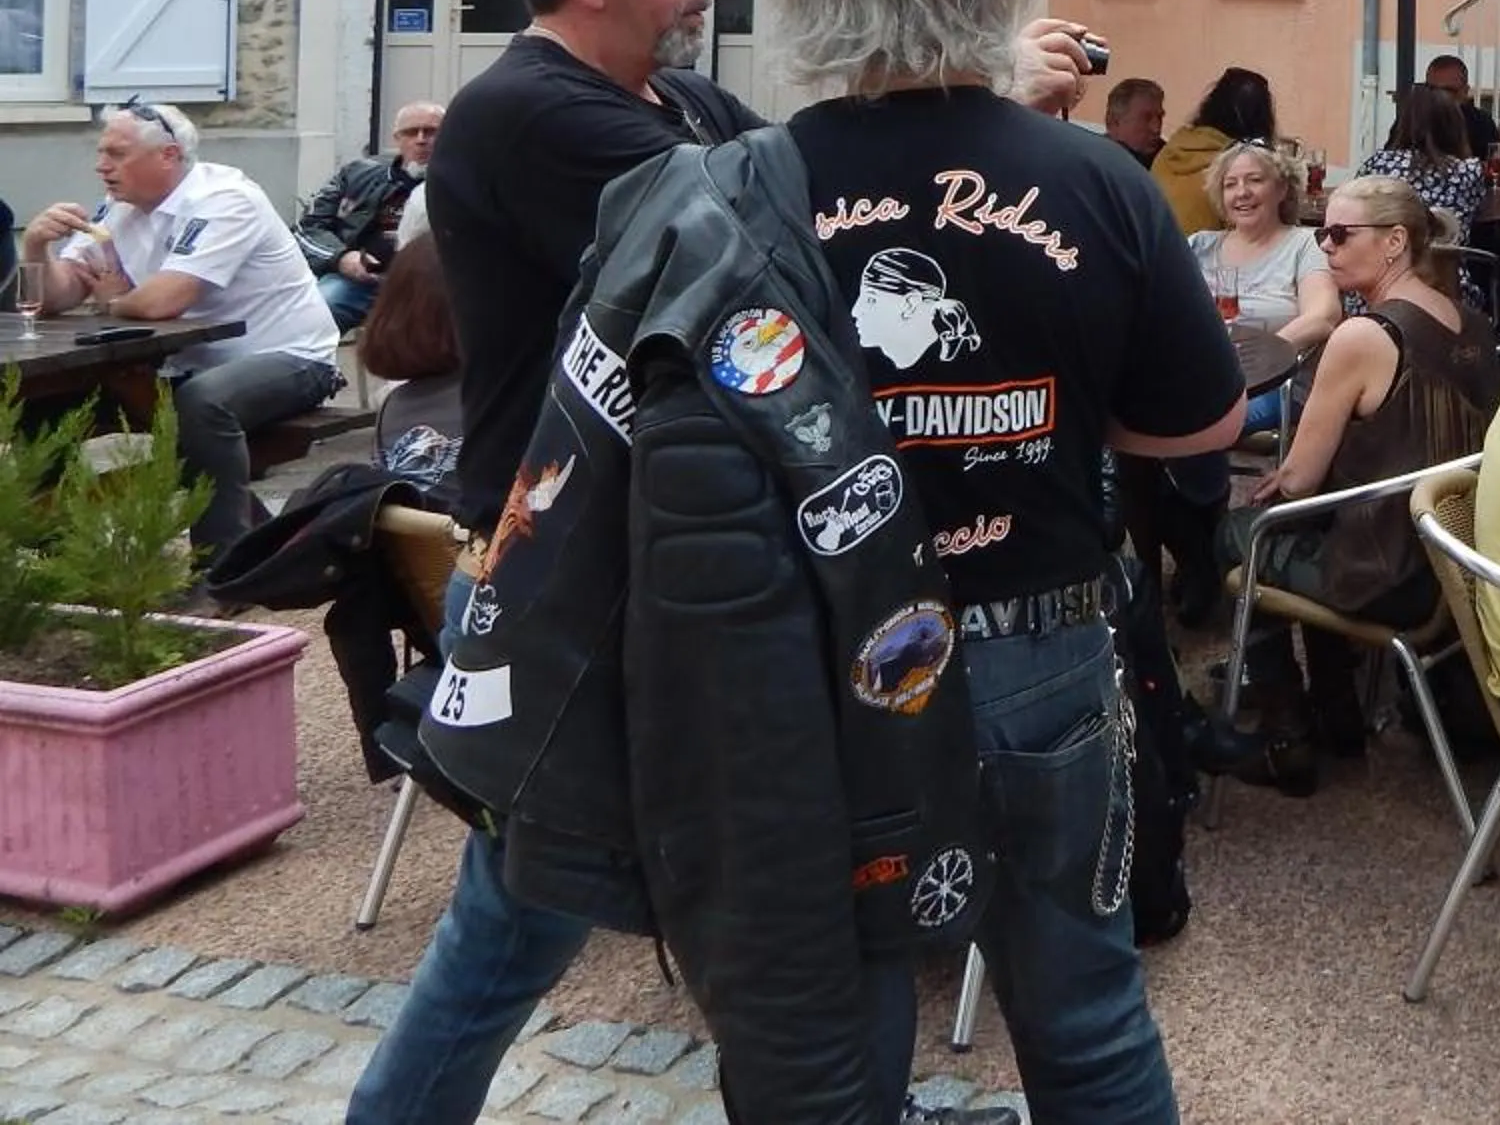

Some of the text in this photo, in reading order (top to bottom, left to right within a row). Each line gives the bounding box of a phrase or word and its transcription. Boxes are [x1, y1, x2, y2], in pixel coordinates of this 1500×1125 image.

[933, 170, 1079, 271] Riders
[568, 326, 607, 388] THE
[963, 446, 1009, 472] Since
